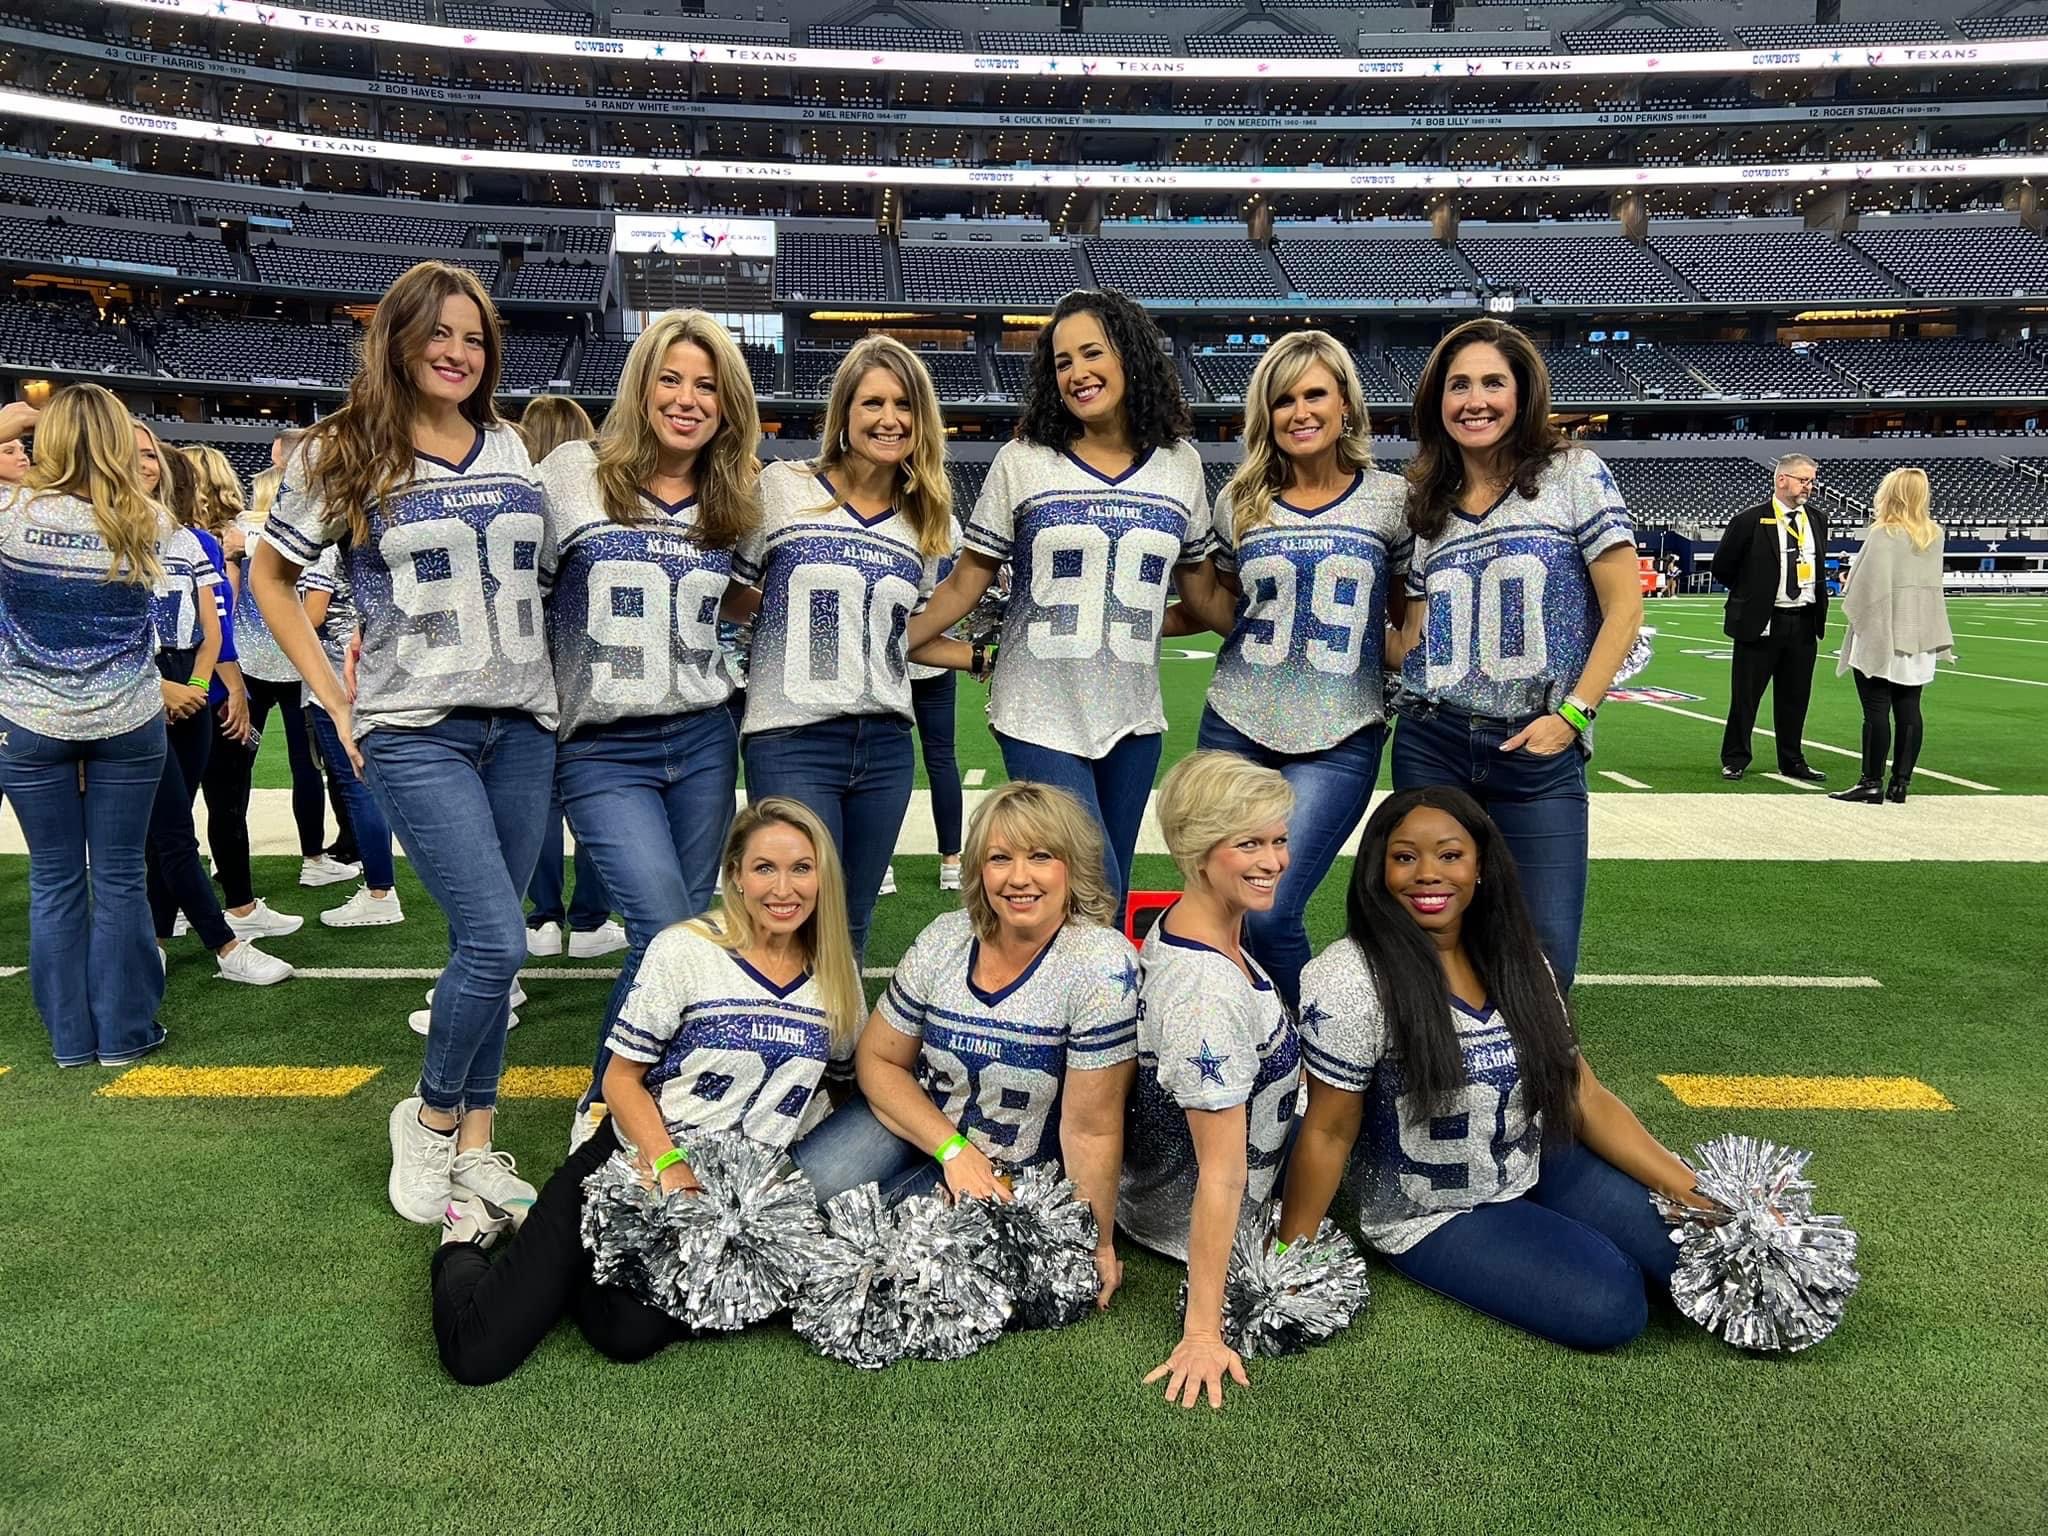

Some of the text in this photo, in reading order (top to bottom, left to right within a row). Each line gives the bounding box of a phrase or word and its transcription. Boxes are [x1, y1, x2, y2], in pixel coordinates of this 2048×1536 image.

[300, 15, 381, 34] TEXANS
[105, 47, 119, 58] 43
[125, 50, 158, 63] CLIFF
[162, 57, 205, 70] HARRIS
[574, 40, 797, 62] COWBOYS TEXANS
[1752, 48, 1978, 65] COWBOYS TEXANS
[974, 58, 1185, 72] COWBOYS TEXANS
[1358, 60, 1572, 73] COWBOYS TEXANS
[368, 83, 380, 92] 22
[385, 85, 408, 95] BOB
[411, 88, 445, 99] HAYES
[585, 100, 597, 108] 54
[602, 101, 634, 110] RANDY
[638, 103, 670, 112] WHITE
[1809, 109, 1819, 117] 12
[1823, 107, 1855, 117] ROGER
[1857, 106, 1904, 115] STAUBACH
[802, 110, 815, 118] 20
[819, 110, 837, 119] MEL
[839, 111, 874, 120] RENFRO
[999, 115, 1010, 124] 54
[1014, 116, 1042, 125] CHUCK
[1045, 116, 1080, 126] HOWLEY
[1204, 119, 1213, 127] 17
[1217, 119, 1235, 127] DON
[1238, 119, 1281, 127] MEREDITH
[1411, 118, 1422, 126] 74
[1425, 118, 1445, 126] BOB
[1447, 118, 1469, 126] LILLY
[1598, 115, 1609, 123] 43
[1613, 114, 1633, 123] DON
[1635, 113, 1673, 122] PERKINS
[119, 114, 378, 154] COWBOYS TEXANS
[572, 158, 792, 176] COWBOYS TEXANS
[1742, 162, 1967, 178] COWBOYS TEXANS
[968, 172, 1177, 184] COWBOYS TEXANS
[1350, 174, 1561, 185] COWBOYS TEXANS
[442, 491, 507, 508] ALUMNI
[1088, 505, 1143, 519] ALUMNI
[1279, 538, 1335, 551] ALUMNI
[842, 547, 895, 565] ALUMNI
[1452, 544, 1498, 564] ALUMNI
[379, 512, 544, 677] 98
[1027, 523, 1181, 666] 99
[1425, 554, 1548, 689] 00
[587, 560, 730, 704] 99
[784, 563, 919, 707] 00
[750, 1023, 806, 1046] ALUMNI
[950, 1034, 1001, 1058] ALUMNI
[1473, 1046, 1516, 1071] ALUM
